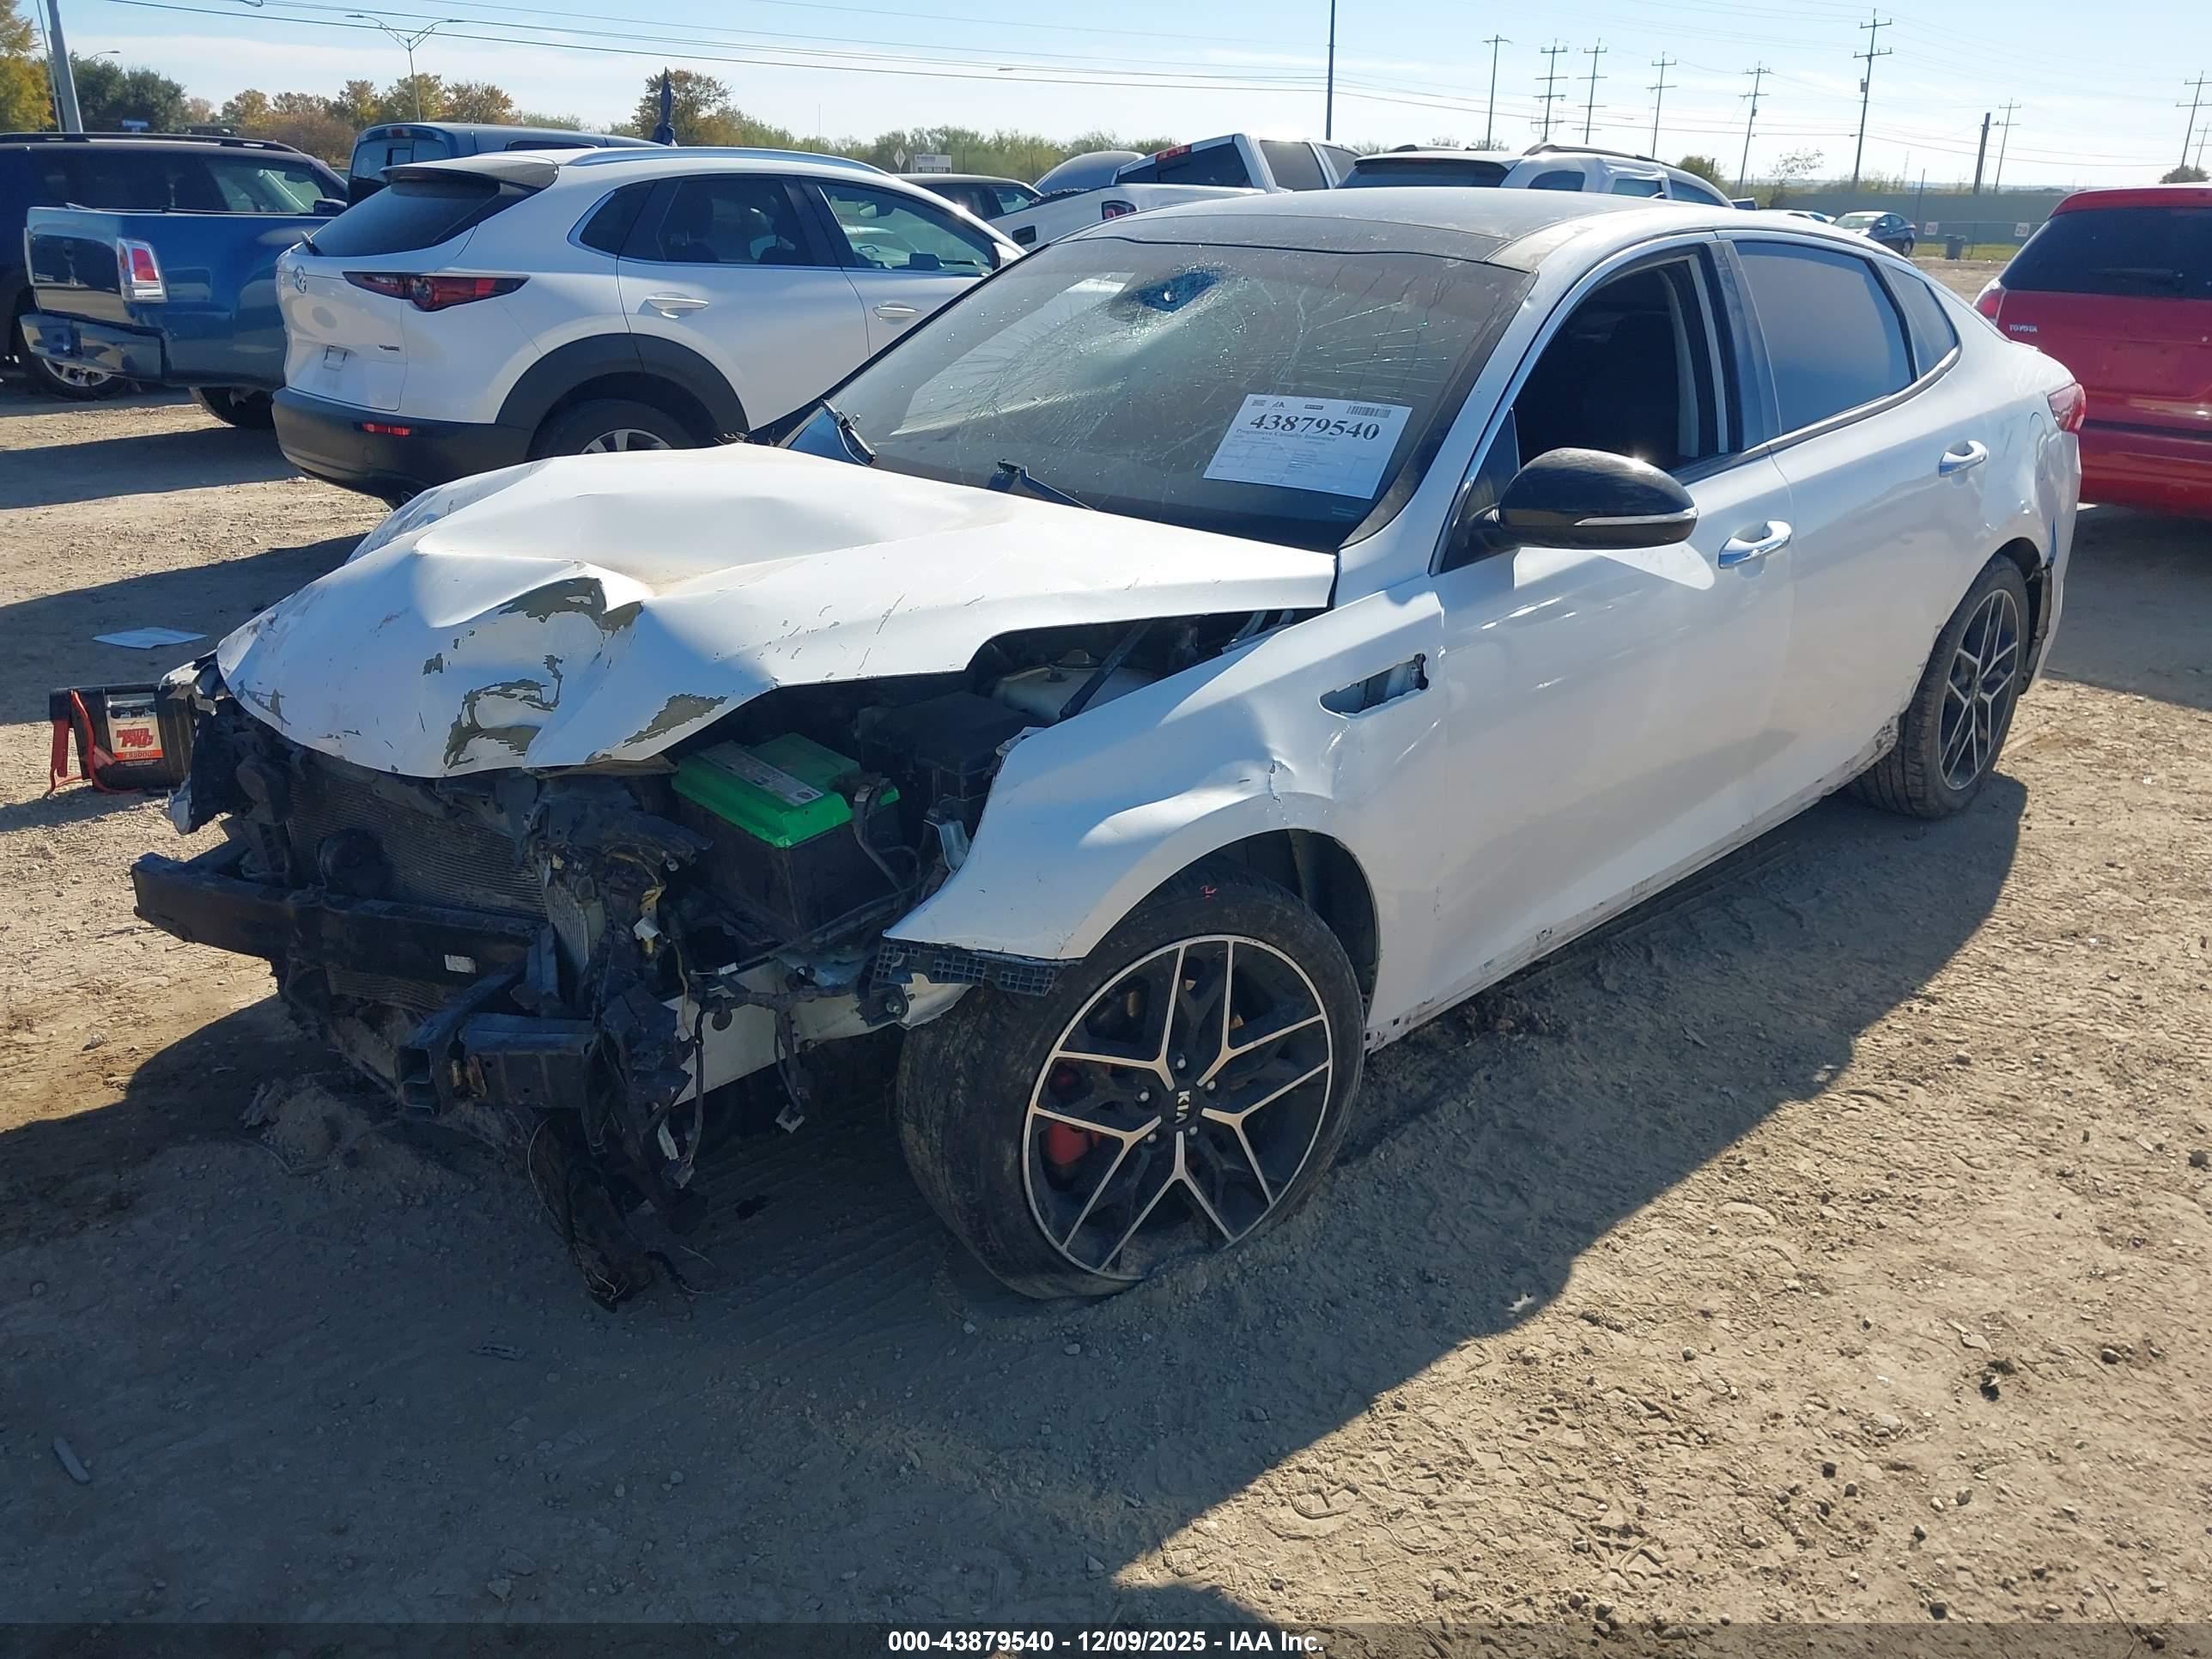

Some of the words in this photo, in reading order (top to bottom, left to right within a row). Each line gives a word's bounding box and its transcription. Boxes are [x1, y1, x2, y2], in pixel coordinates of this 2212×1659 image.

[2009, 324, 2038, 332] TOYOTA
[1249, 413, 1380, 441] 43879540
[1175, 1090, 1190, 1124] KIA
